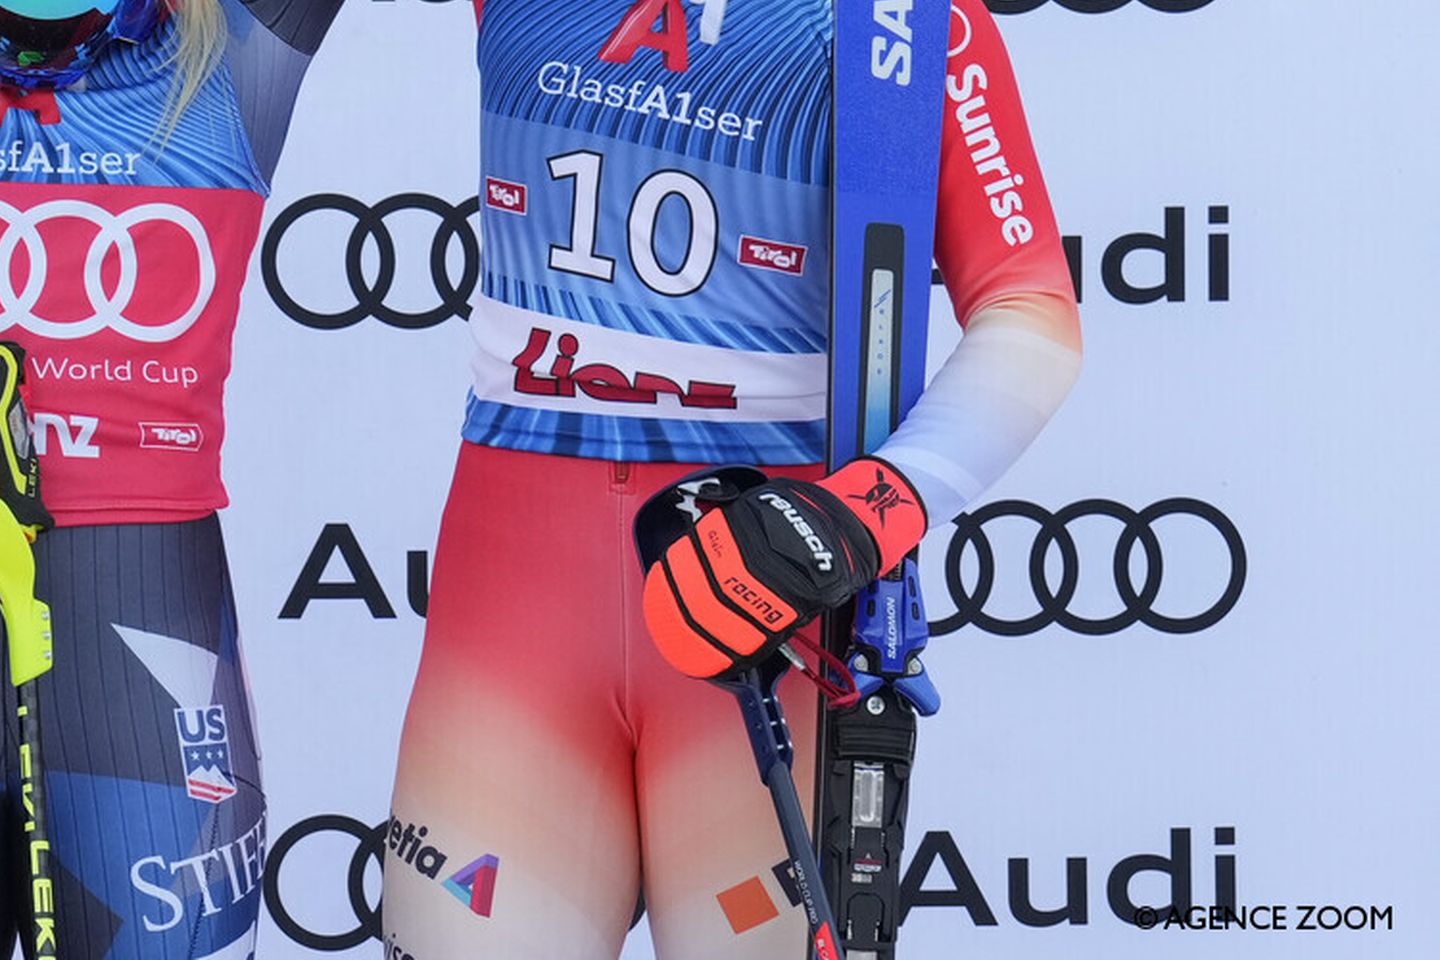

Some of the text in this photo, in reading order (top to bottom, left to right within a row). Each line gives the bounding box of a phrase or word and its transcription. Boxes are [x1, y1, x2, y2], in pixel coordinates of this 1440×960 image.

[538, 61, 763, 141] GlasfA1ser
[946, 63, 1034, 247] Sunrise
[489, 184, 520, 208] Tirol
[546, 149, 719, 298] 10
[748, 244, 797, 268] Tirol
[32, 356, 131, 382] World
[142, 361, 198, 387] Cup
[759, 493, 833, 571] reusch
[724, 576, 784, 624] racing
[887, 596, 897, 659] SALOMON
[179, 707, 226, 743] US
[389, 815, 448, 880] etia
[898, 826, 1235, 928] Audi
